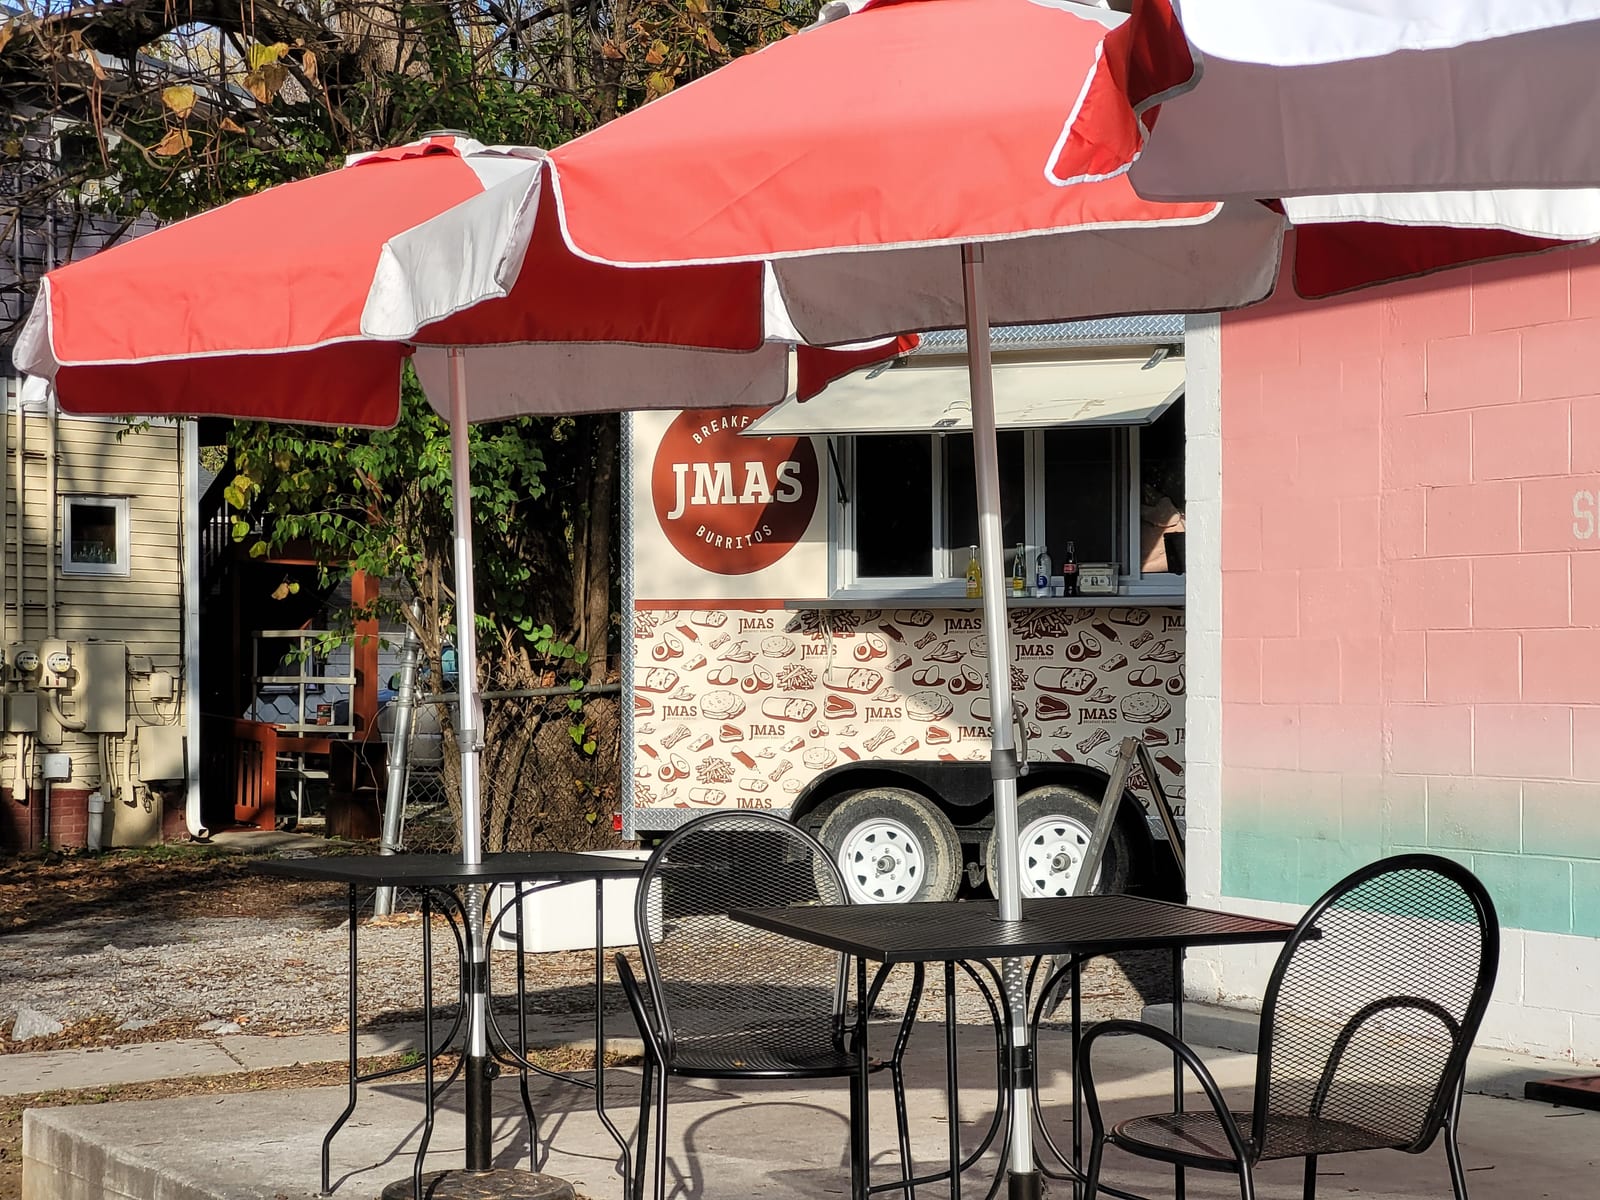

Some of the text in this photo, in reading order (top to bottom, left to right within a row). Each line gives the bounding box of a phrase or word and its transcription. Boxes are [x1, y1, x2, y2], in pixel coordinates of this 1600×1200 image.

[692, 415, 772, 444] BREAKF
[667, 461, 803, 519] JMAS
[696, 525, 772, 549] BURRITOS
[738, 618, 774, 634] JMAS
[944, 618, 982, 635] JMAS
[800, 644, 837, 660] JMAS
[1015, 644, 1054, 661] JMAS
[661, 705, 697, 721] JMAS
[864, 707, 902, 723] JMAS
[1077, 708, 1117, 725] JMAS
[749, 724, 785, 740] JMAS
